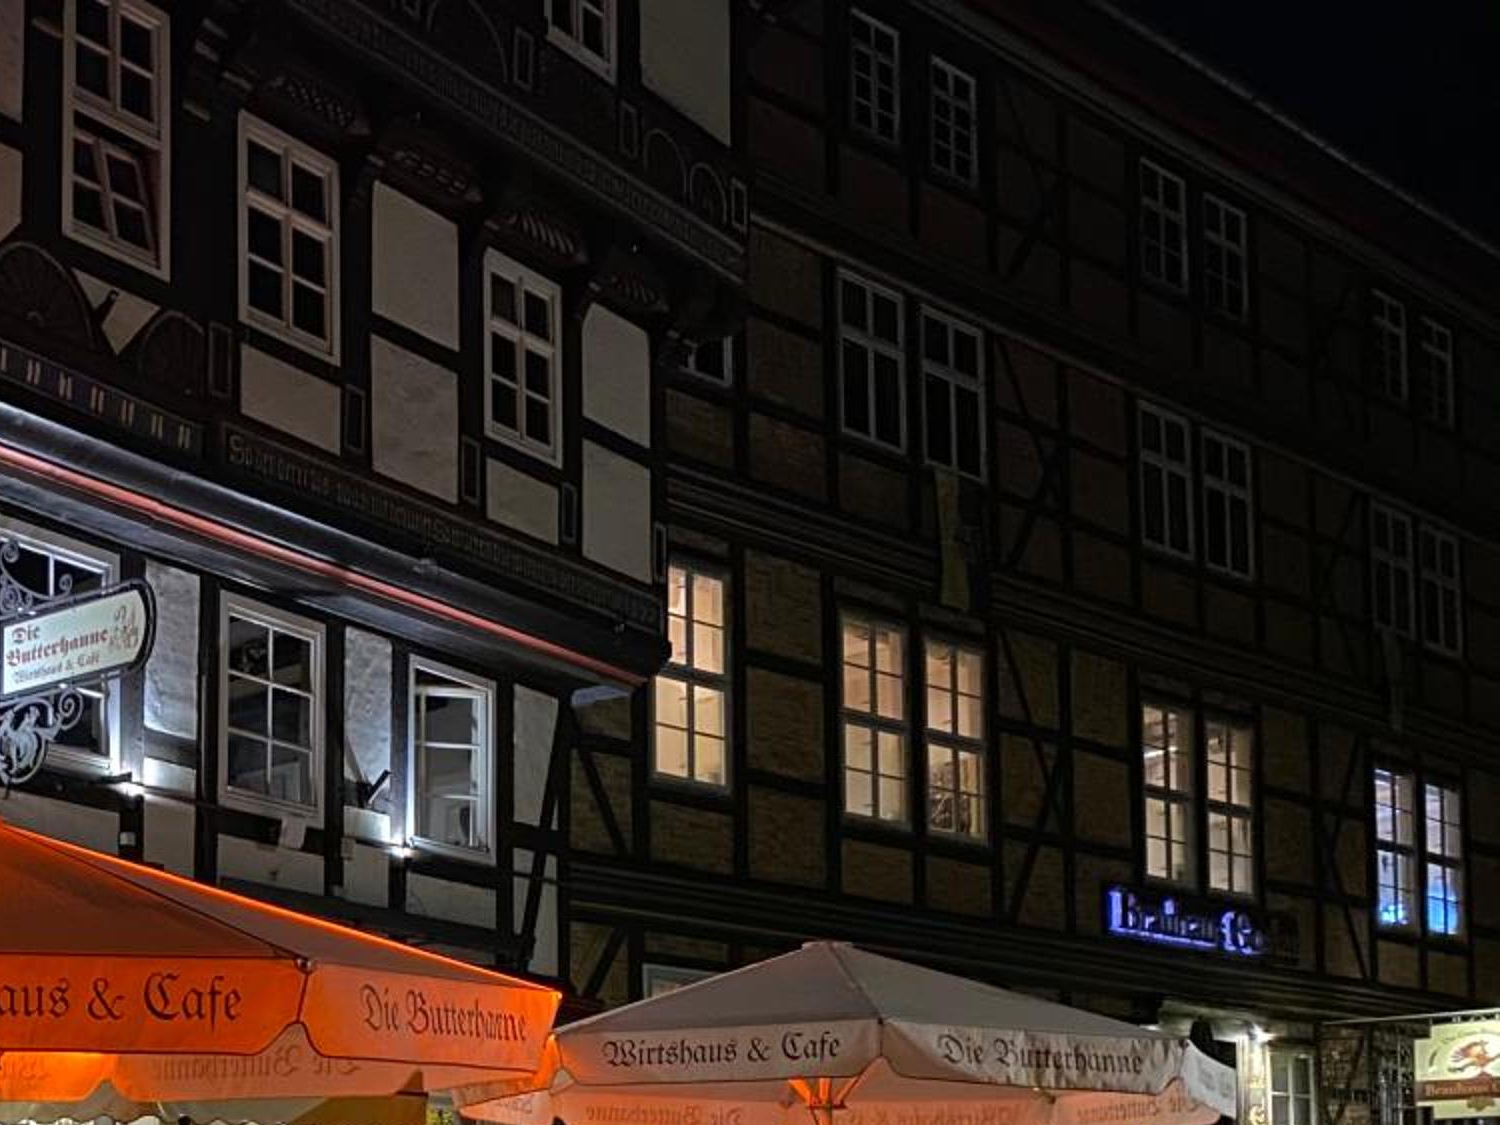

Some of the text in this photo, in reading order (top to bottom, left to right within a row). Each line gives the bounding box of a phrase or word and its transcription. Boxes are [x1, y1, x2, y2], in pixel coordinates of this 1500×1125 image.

[6, 627, 109, 668] Butterhanne
[11, 623, 41, 645] Die
[86, 977, 125, 1021] &
[143, 972, 242, 1032] Cafe
[359, 983, 527, 1042] Die Butterhanne
[602, 1029, 841, 1068] Wirtshaus & Cafe
[935, 1033, 1144, 1077] Die Butterhanne
